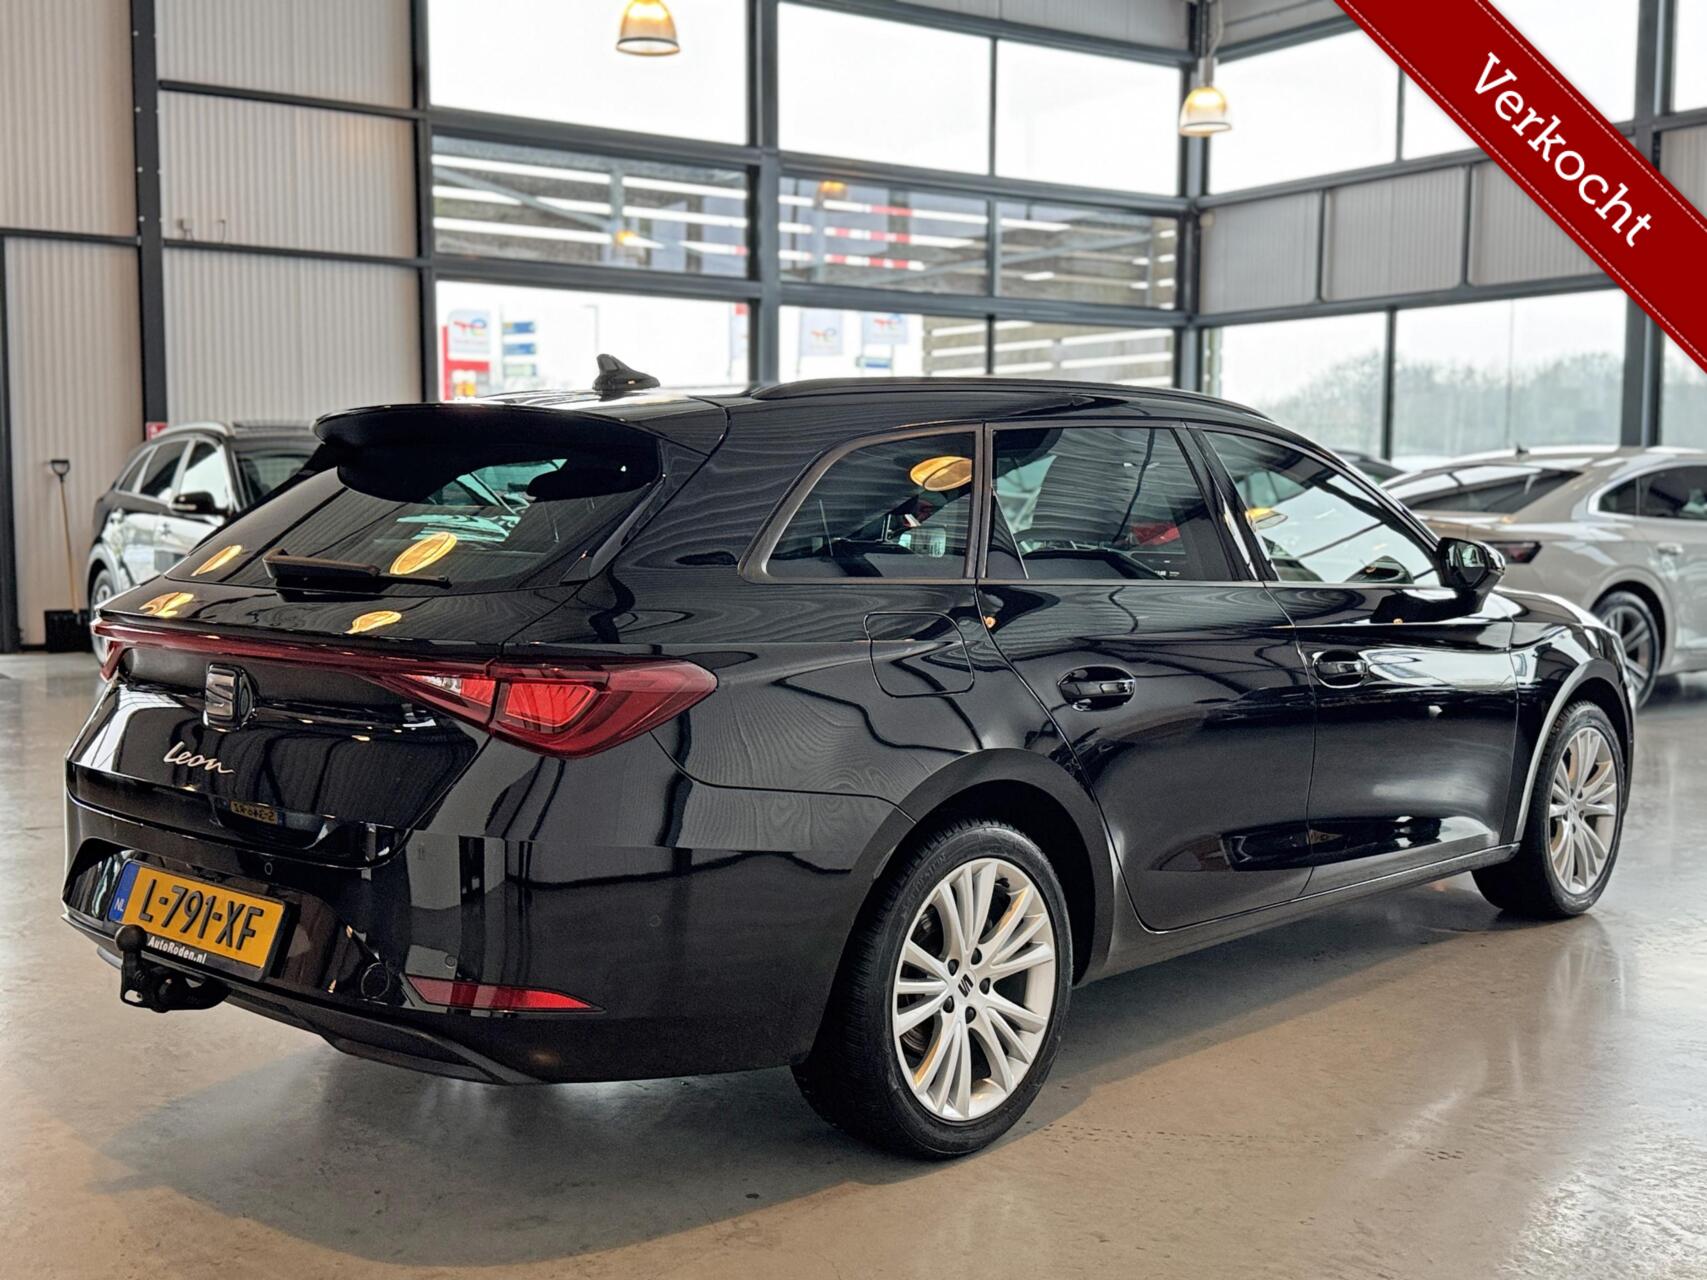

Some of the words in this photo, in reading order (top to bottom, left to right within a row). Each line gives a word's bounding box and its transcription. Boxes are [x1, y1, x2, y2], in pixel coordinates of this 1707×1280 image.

[163, 741, 236, 774] Leon
[114, 898, 125, 912] NL
[139, 879, 264, 950] L-791-XF
[147, 935, 207, 964] AutoRoden.nl
